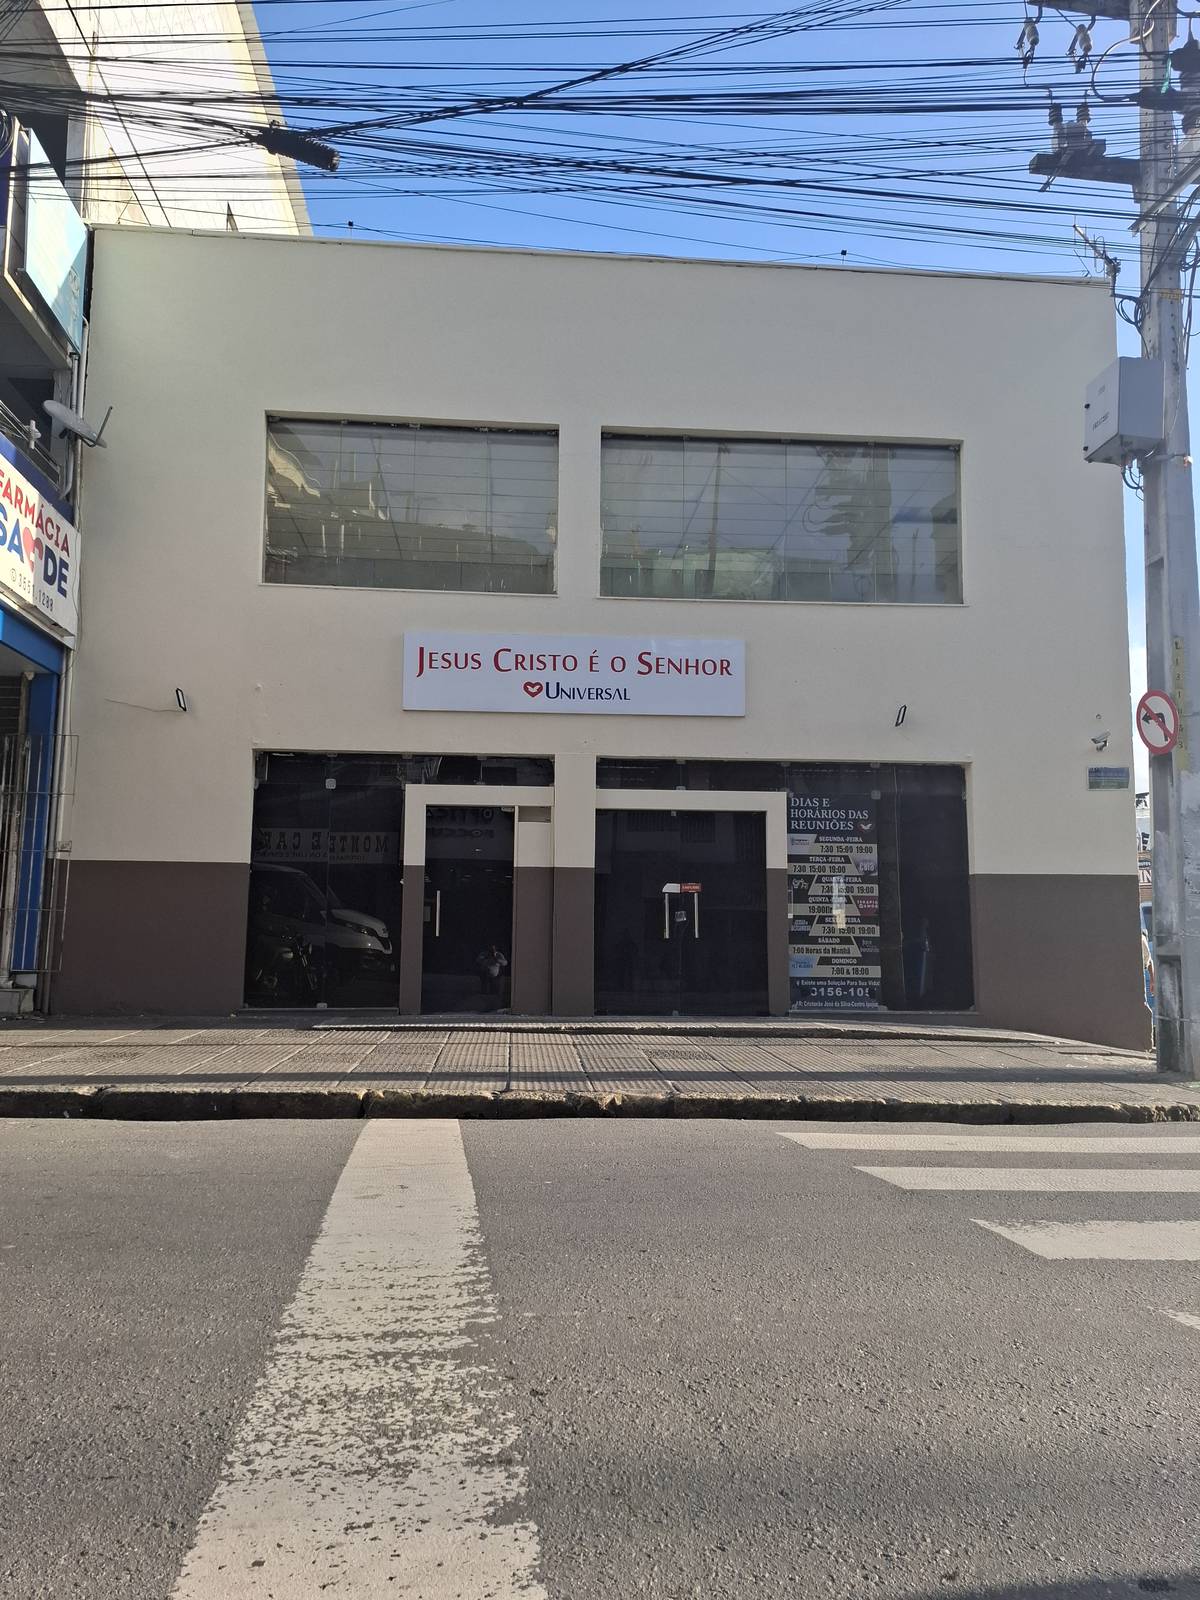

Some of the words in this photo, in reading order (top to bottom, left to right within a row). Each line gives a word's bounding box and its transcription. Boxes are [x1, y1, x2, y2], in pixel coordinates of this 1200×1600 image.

[416, 646, 482, 678] JESUS
[493, 648, 578, 673] CRISTO
[589, 649, 599, 673] É
[610, 655, 627, 673] O
[637, 651, 734, 676] SENHOR
[545, 682, 631, 701] UNIVERSAL
[791, 797, 819, 807] DIAS
[822, 798, 830, 807] E
[791, 807, 846, 819] HORÁRIOS
[848, 810, 869, 820] DAS
[791, 819, 854, 831] REUNIÕES
